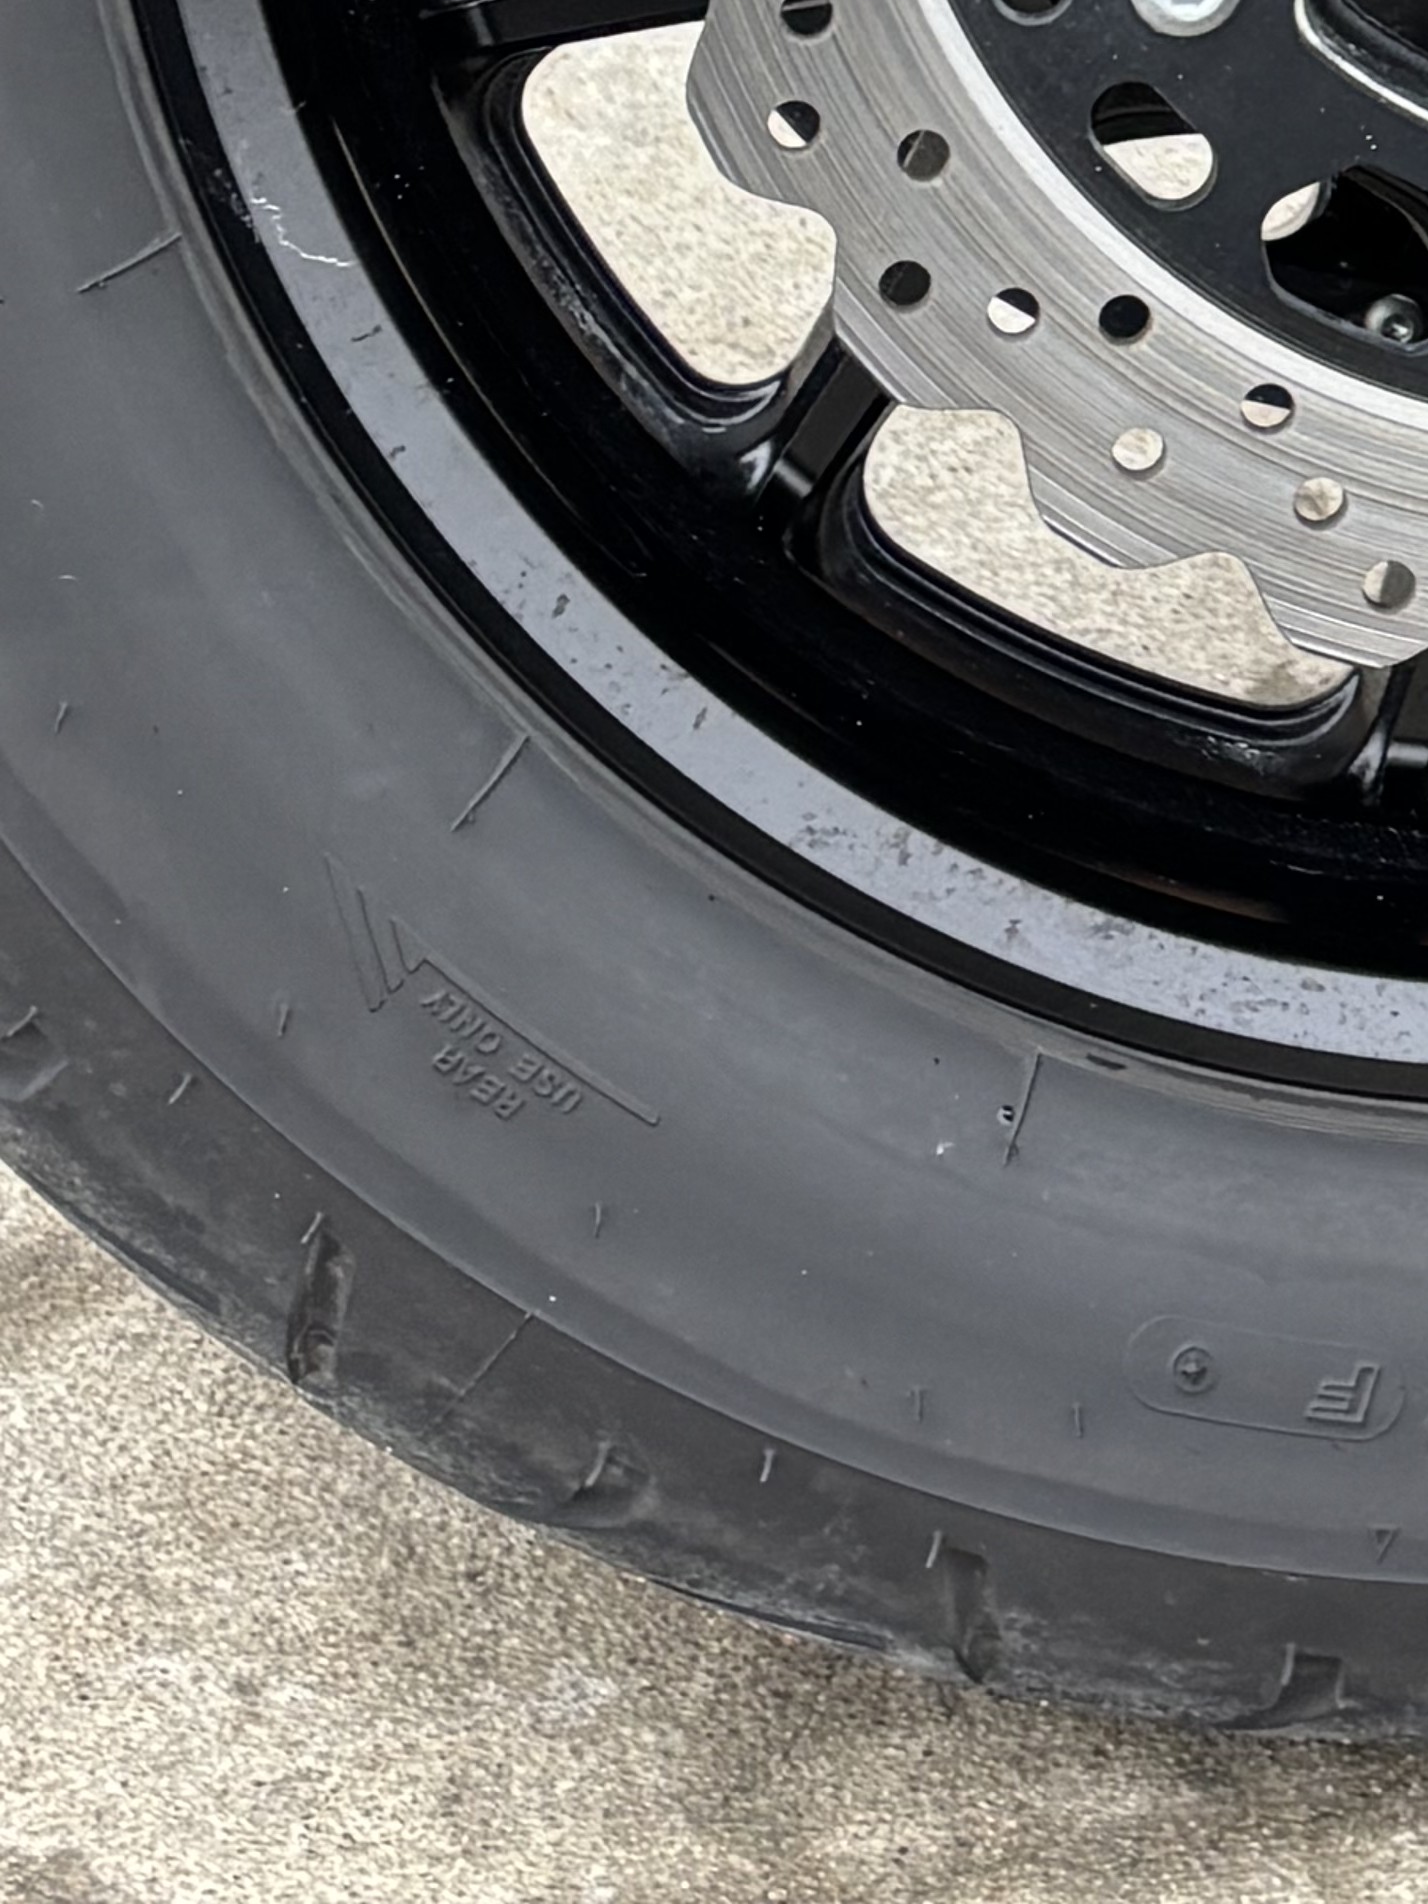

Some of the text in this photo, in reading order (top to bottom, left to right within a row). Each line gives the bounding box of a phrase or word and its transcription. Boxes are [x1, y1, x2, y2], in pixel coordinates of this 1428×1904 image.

[418, 989, 582, 1114] USE ONLY
[432, 1044, 527, 1120] REAR
